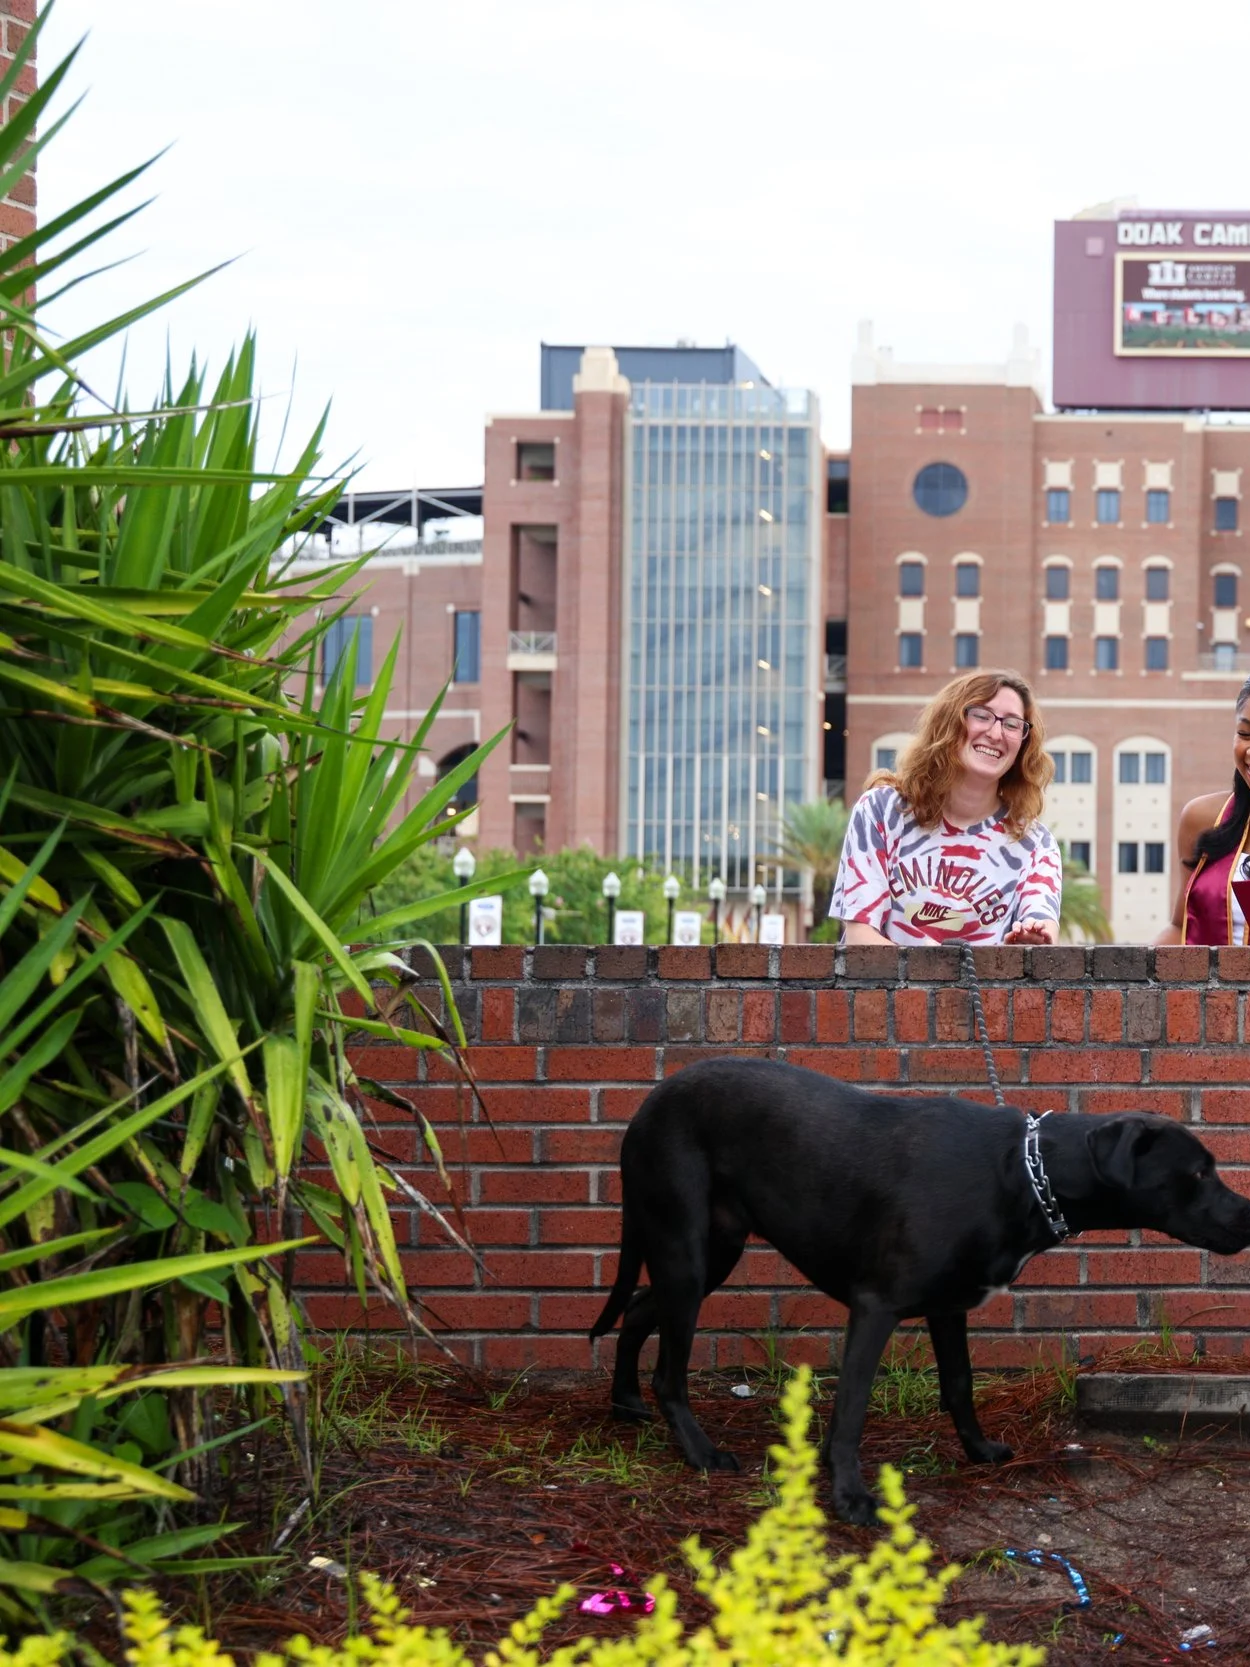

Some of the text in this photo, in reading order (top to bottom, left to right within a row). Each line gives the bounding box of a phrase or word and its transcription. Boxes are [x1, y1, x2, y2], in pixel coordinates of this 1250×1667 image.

[1117, 222, 1184, 246] DOAK
[887, 855, 1009, 926] EMINOLES
[919, 902, 952, 918] NIKE
